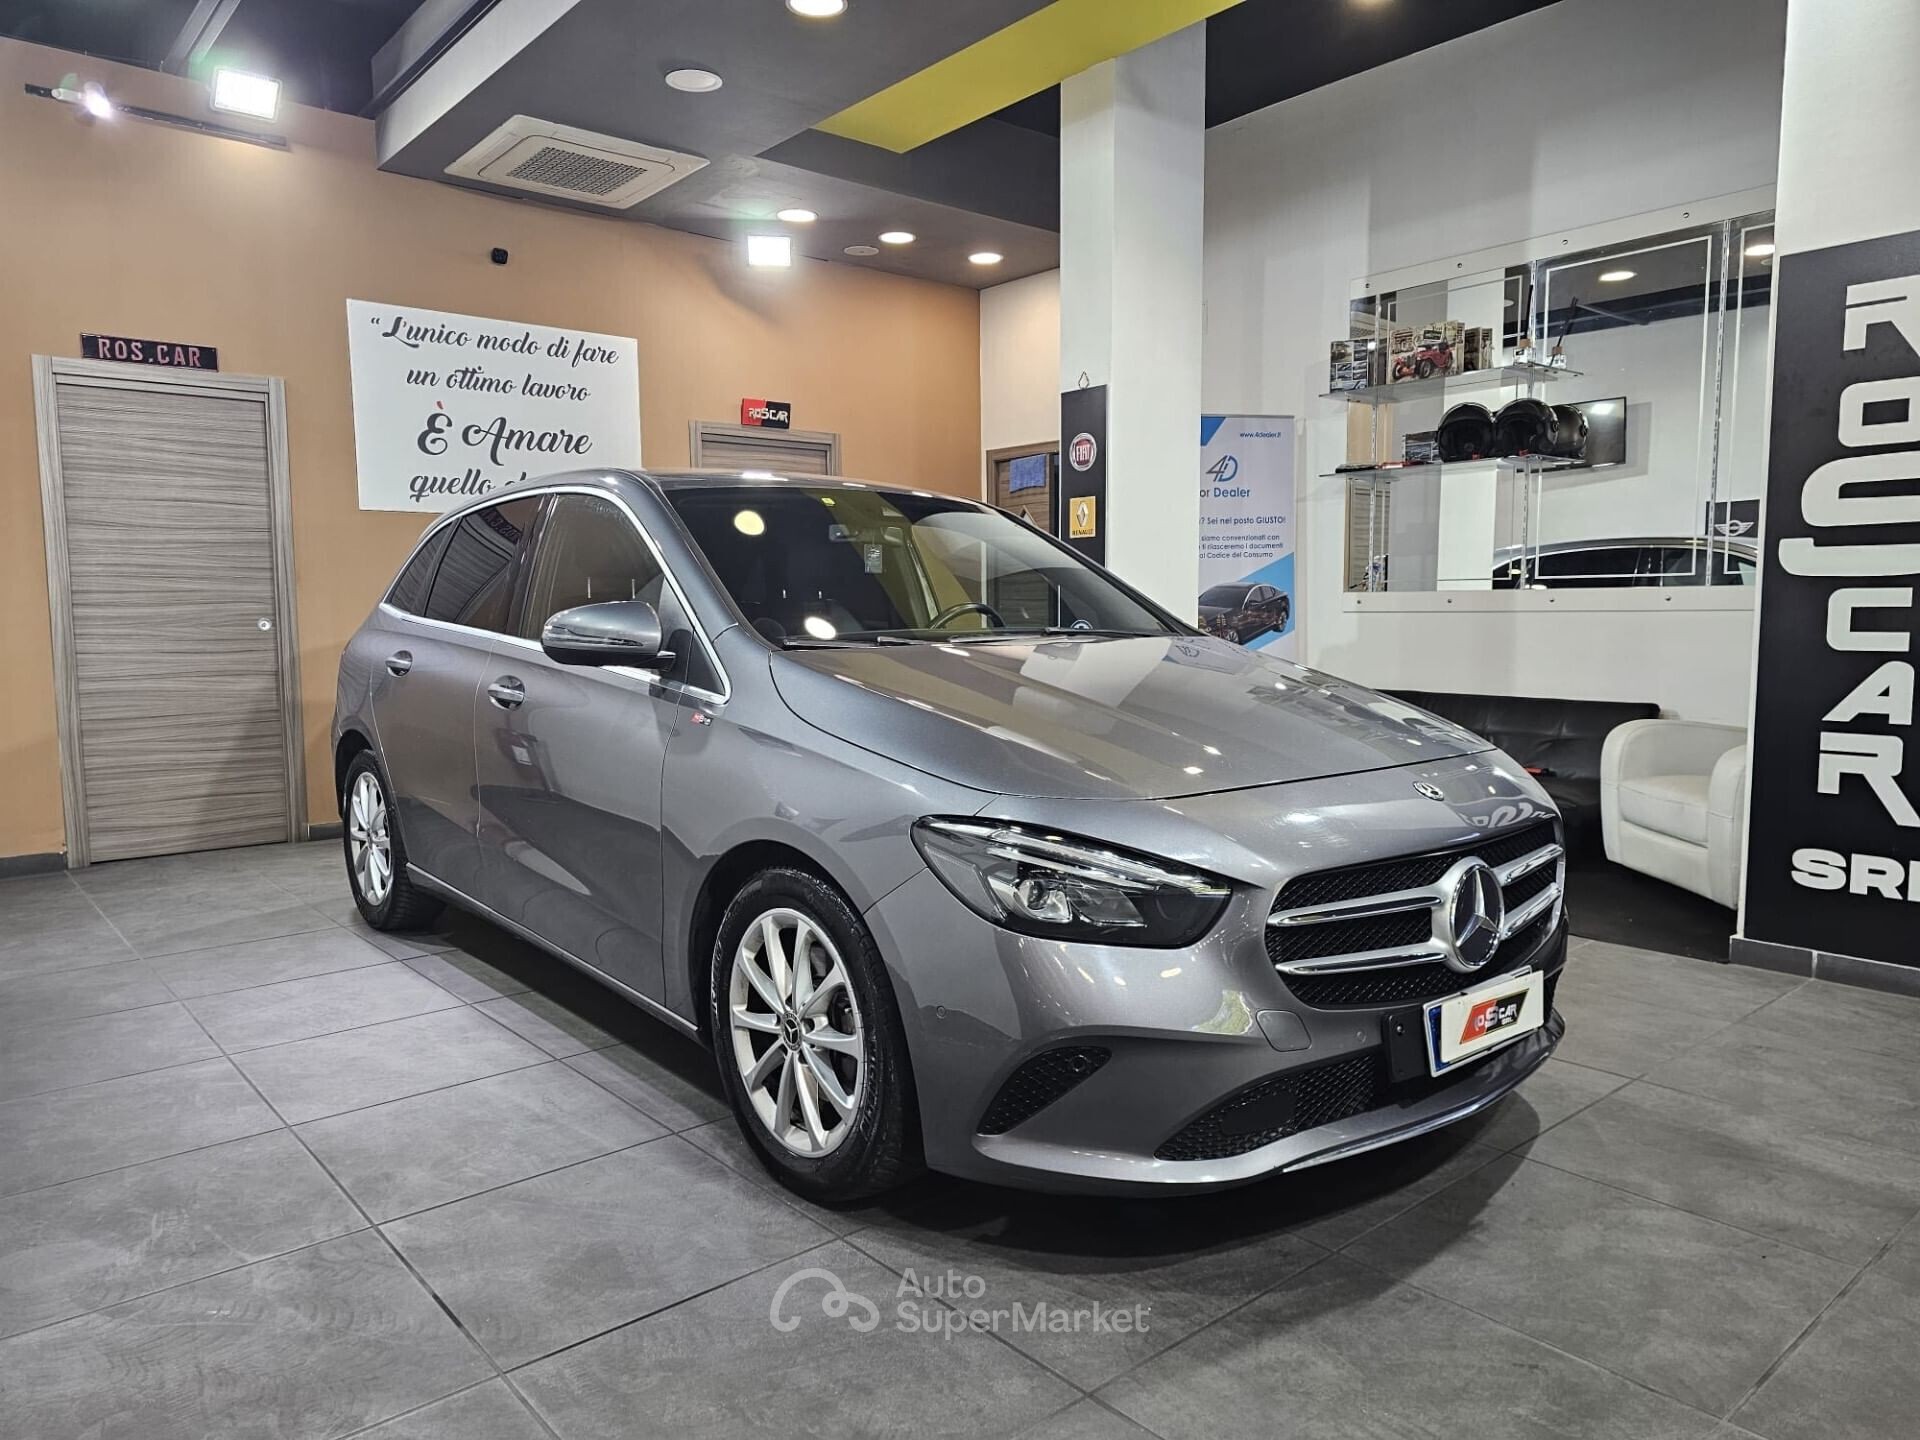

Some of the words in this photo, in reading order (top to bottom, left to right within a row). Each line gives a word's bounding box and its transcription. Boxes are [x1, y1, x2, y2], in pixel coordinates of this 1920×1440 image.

[98, 338, 201, 367] ROS.CAR
[477, 332, 541, 355] modo
[547, 336, 570, 358] di
[571, 339, 619, 367] fare
[406, 368, 440, 387] un
[446, 366, 517, 393] ottimo
[522, 374, 591, 401] lavoro
[417, 401, 452, 455] È
[462, 417, 593, 466] Amare
[1076, 444, 1091, 462] FIAT
[409, 468, 496, 502] quello
[1213, 487, 1251, 498] Dealer
[1071, 528, 1094, 536] RENAULT
[1207, 516, 1218, 524] Sei
[1220, 516, 1232, 524] nel
[1233, 516, 1255, 525] posto
[1255, 515, 1286, 524] GIUSTO!
